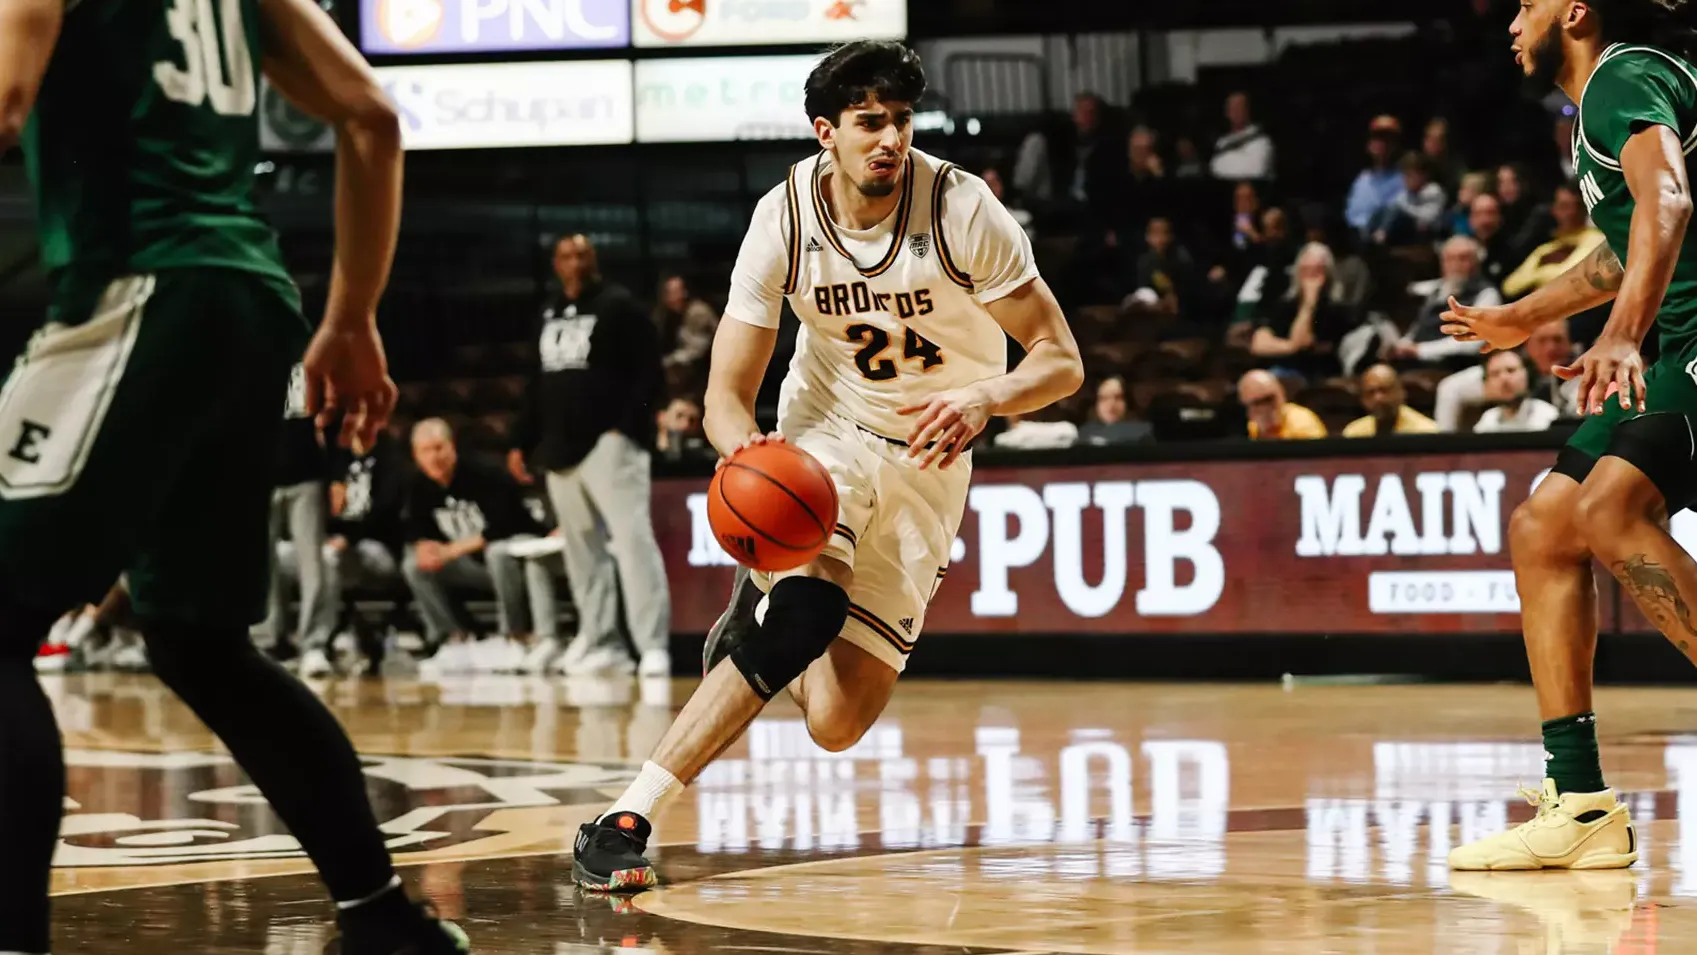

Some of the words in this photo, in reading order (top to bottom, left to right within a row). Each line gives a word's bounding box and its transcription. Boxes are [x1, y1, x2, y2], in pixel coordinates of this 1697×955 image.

[460, 0, 619, 43] PNC
[152, 0, 256, 116] 30
[843, 322, 946, 382] 24
[8, 418, 52, 464] E
[1295, 470, 1506, 557] MAIN
[968, 479, 1225, 617] PUB
[1389, 581, 1455, 604] FOOD
